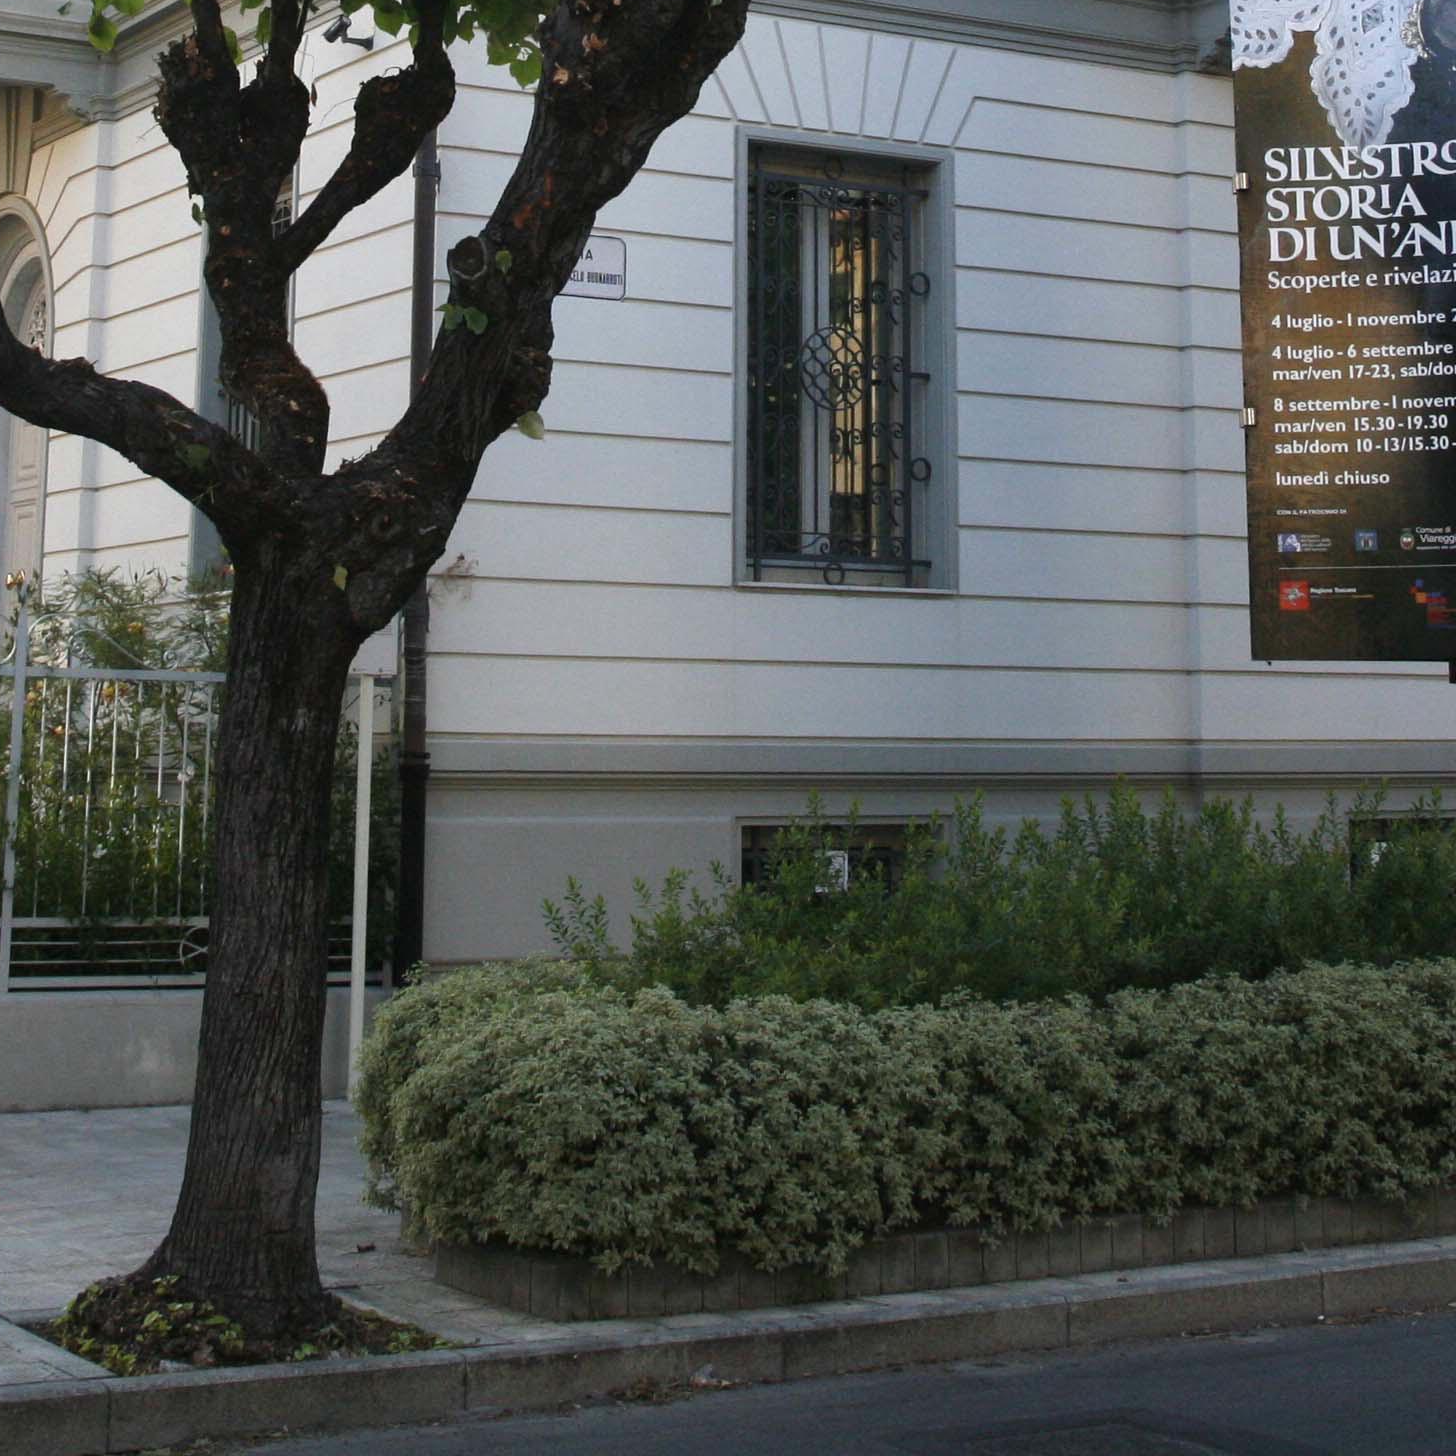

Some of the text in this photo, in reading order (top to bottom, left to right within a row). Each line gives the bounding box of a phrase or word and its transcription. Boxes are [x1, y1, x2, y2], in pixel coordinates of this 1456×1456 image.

[1264, 183, 1428, 223] STORIA
[1267, 225, 1318, 263] DI
[1267, 270, 1361, 294] Scoperte
[1365, 273, 1378, 287] e
[1271, 314, 1281, 328] 4
[1286, 314, 1334, 332] luglio
[1357, 310, 1446, 327] novembre
[1271, 345, 1282, 360] 4
[1287, 345, 1334, 363] luglio
[1346, 344, 1357, 359] 6
[1362, 341, 1454, 358] settembre
[1272, 365, 1342, 381] mar/ven
[1273, 397, 1284, 413] 8
[1288, 396, 1381, 413] settembre
[1274, 418, 1346, 433] mar/ven
[1274, 439, 1349, 455] sab/dom
[1334, 470, 1391, 486] chiuso
[1415, 526, 1452, 534] Comune di
